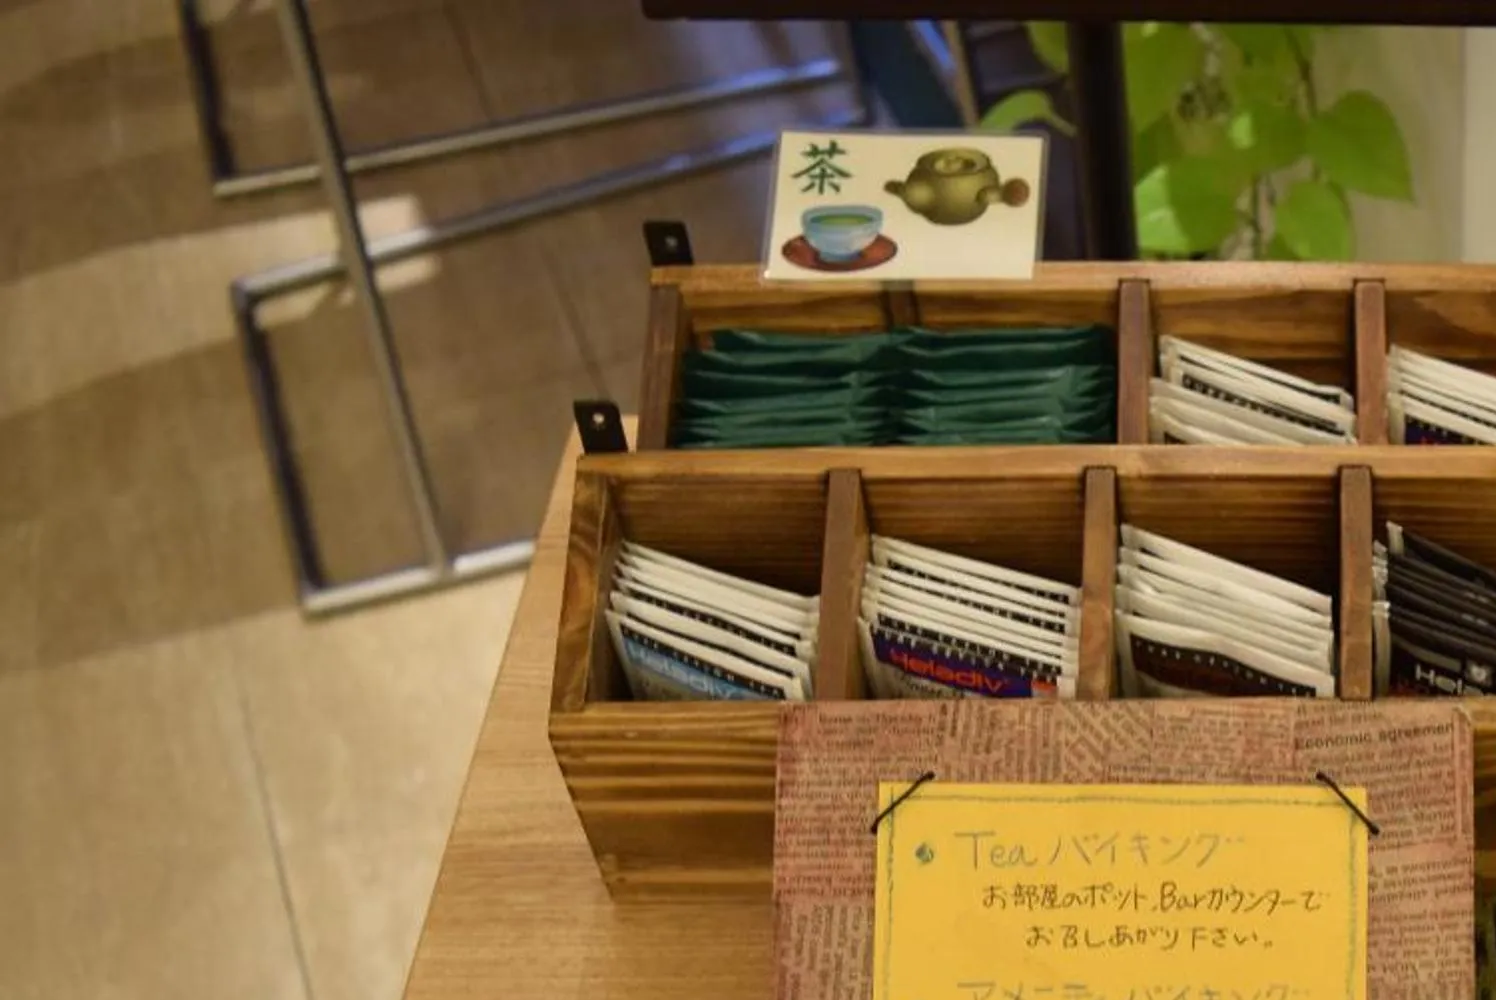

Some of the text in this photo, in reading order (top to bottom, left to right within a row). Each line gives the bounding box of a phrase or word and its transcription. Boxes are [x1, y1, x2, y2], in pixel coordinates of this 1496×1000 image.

[791, 140, 852, 195] 茶
[954, 831, 1246, 870] Tea バイキング
